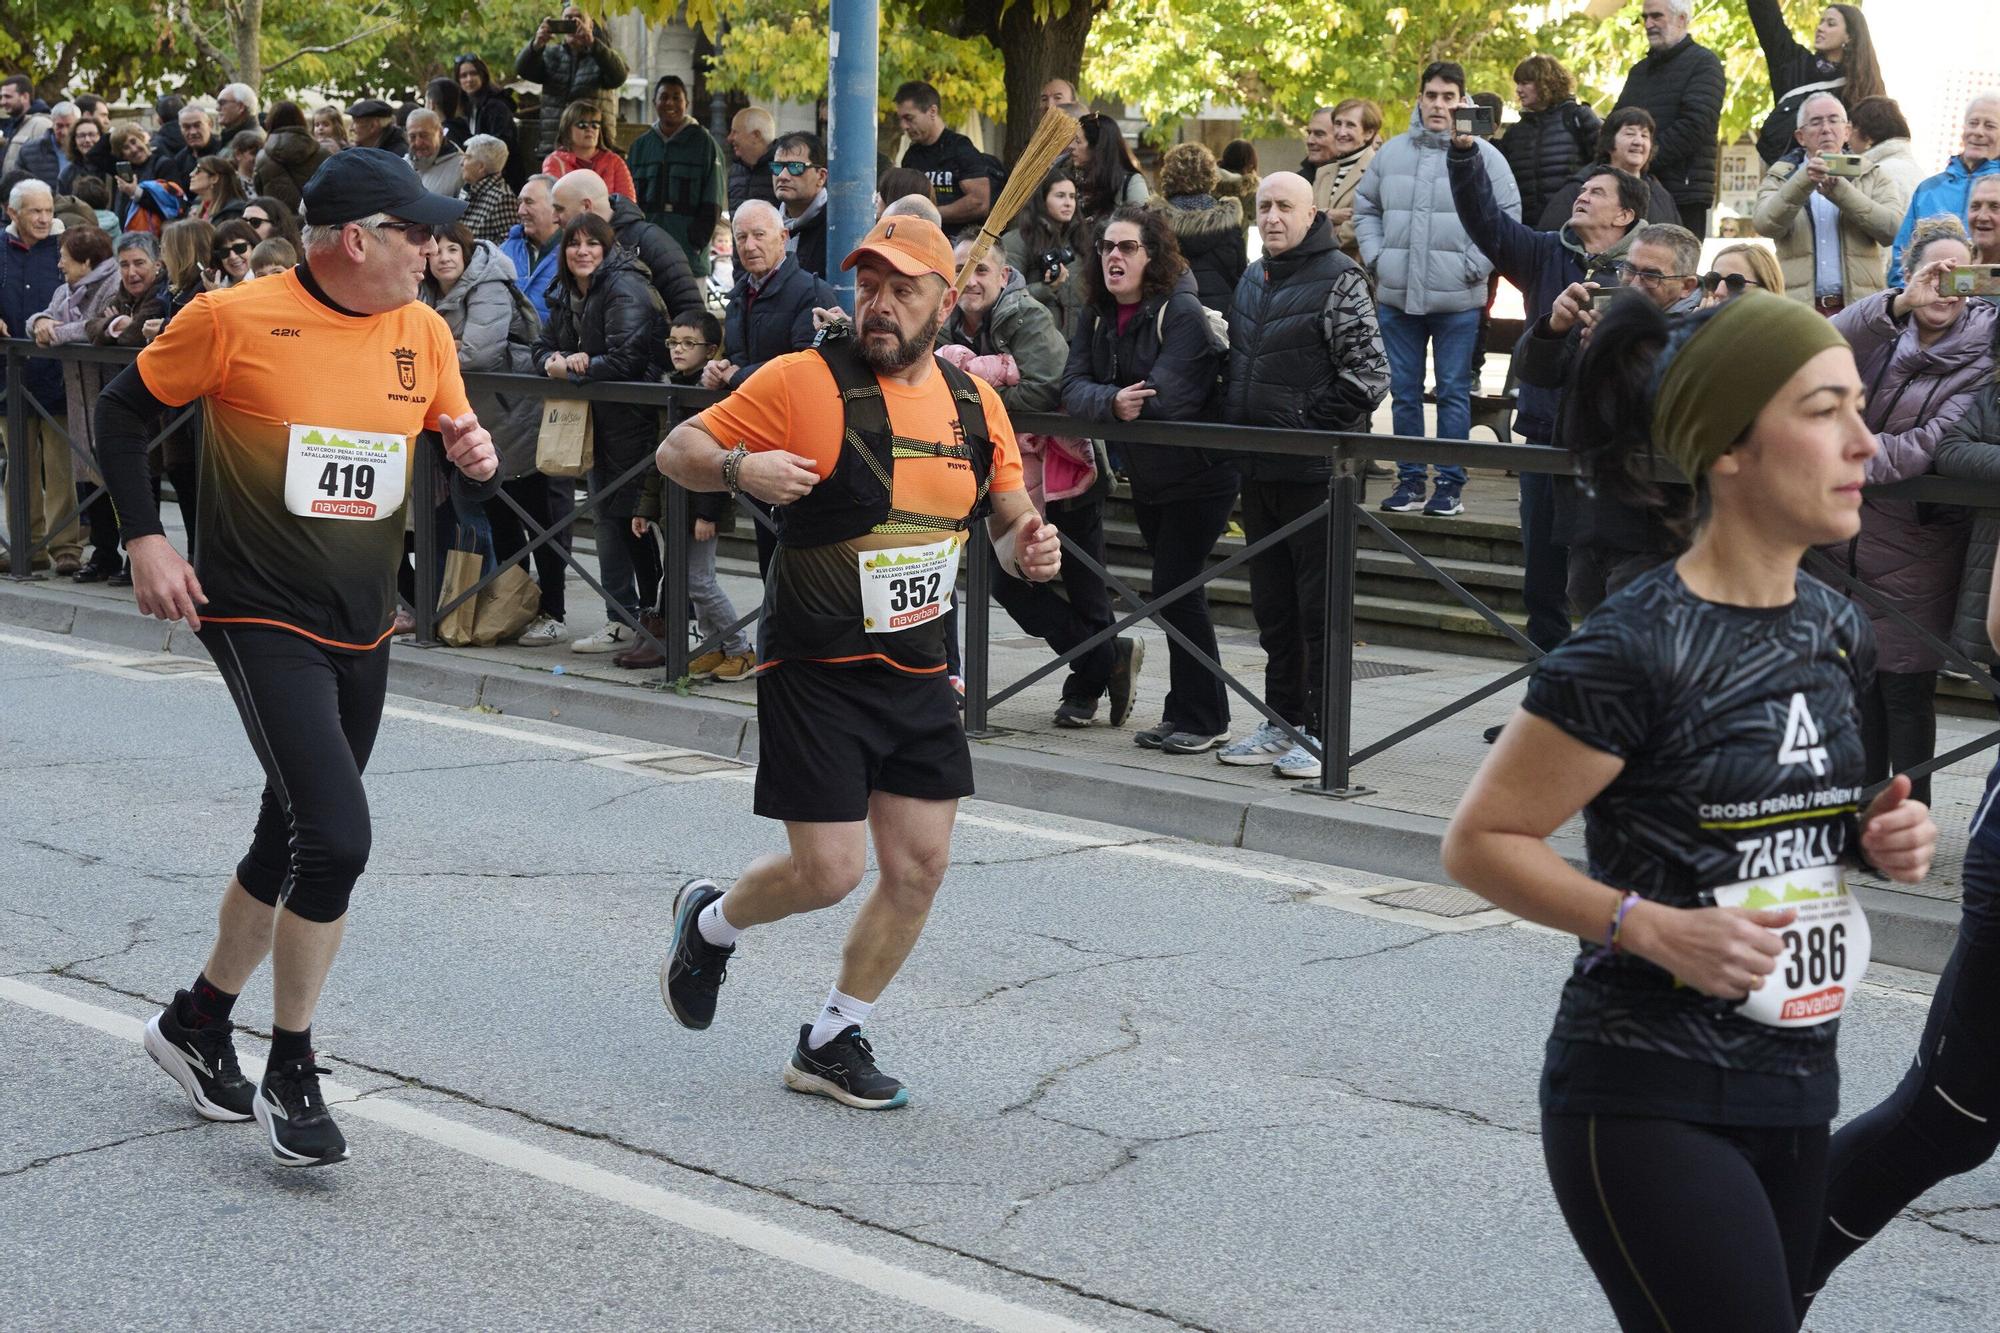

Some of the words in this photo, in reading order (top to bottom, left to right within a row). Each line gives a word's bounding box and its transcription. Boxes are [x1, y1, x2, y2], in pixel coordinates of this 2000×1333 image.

[271, 328, 301, 337] 42K
[301, 451, 333, 459] TAFALLAKO
[318, 462, 375, 499] 419
[315, 501, 373, 515] navarban
[889, 572, 940, 611] 352
[893, 606, 938, 626] navarban
[1699, 802, 1758, 818] CROSS
[1760, 793, 1805, 814] PEÑAS
[1814, 787, 1852, 806] PEÑEN
[1736, 822, 1845, 879] TAFALL
[1782, 923, 1846, 989] 386
